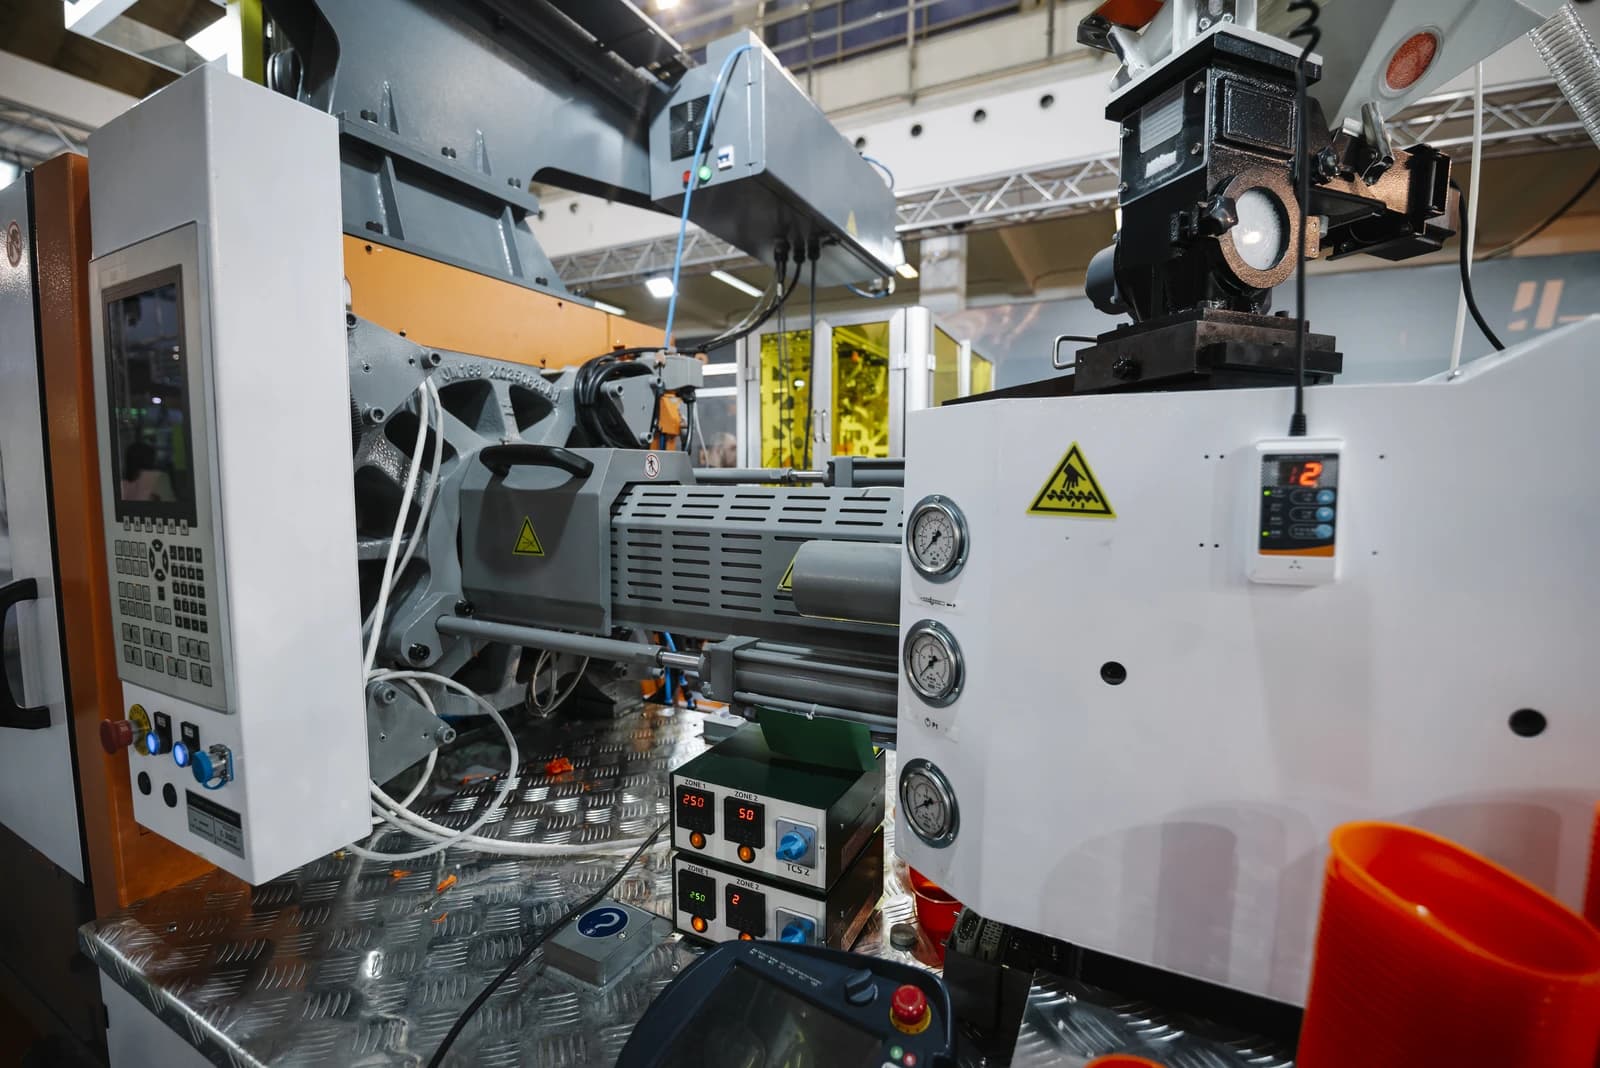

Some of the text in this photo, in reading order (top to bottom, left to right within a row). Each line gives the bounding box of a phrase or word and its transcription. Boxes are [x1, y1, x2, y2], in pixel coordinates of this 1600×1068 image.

[685, 779, 702, 788] ZONE
[683, 794, 704, 807] 250
[734, 791, 752, 800] ZONE
[738, 808, 754, 820] 50
[688, 864, 704, 874] ZONE
[786, 864, 810, 876] TCS 2
[736, 879, 753, 889] ZONE
[690, 891, 706, 902] 250
[732, 894, 741, 904] 2
